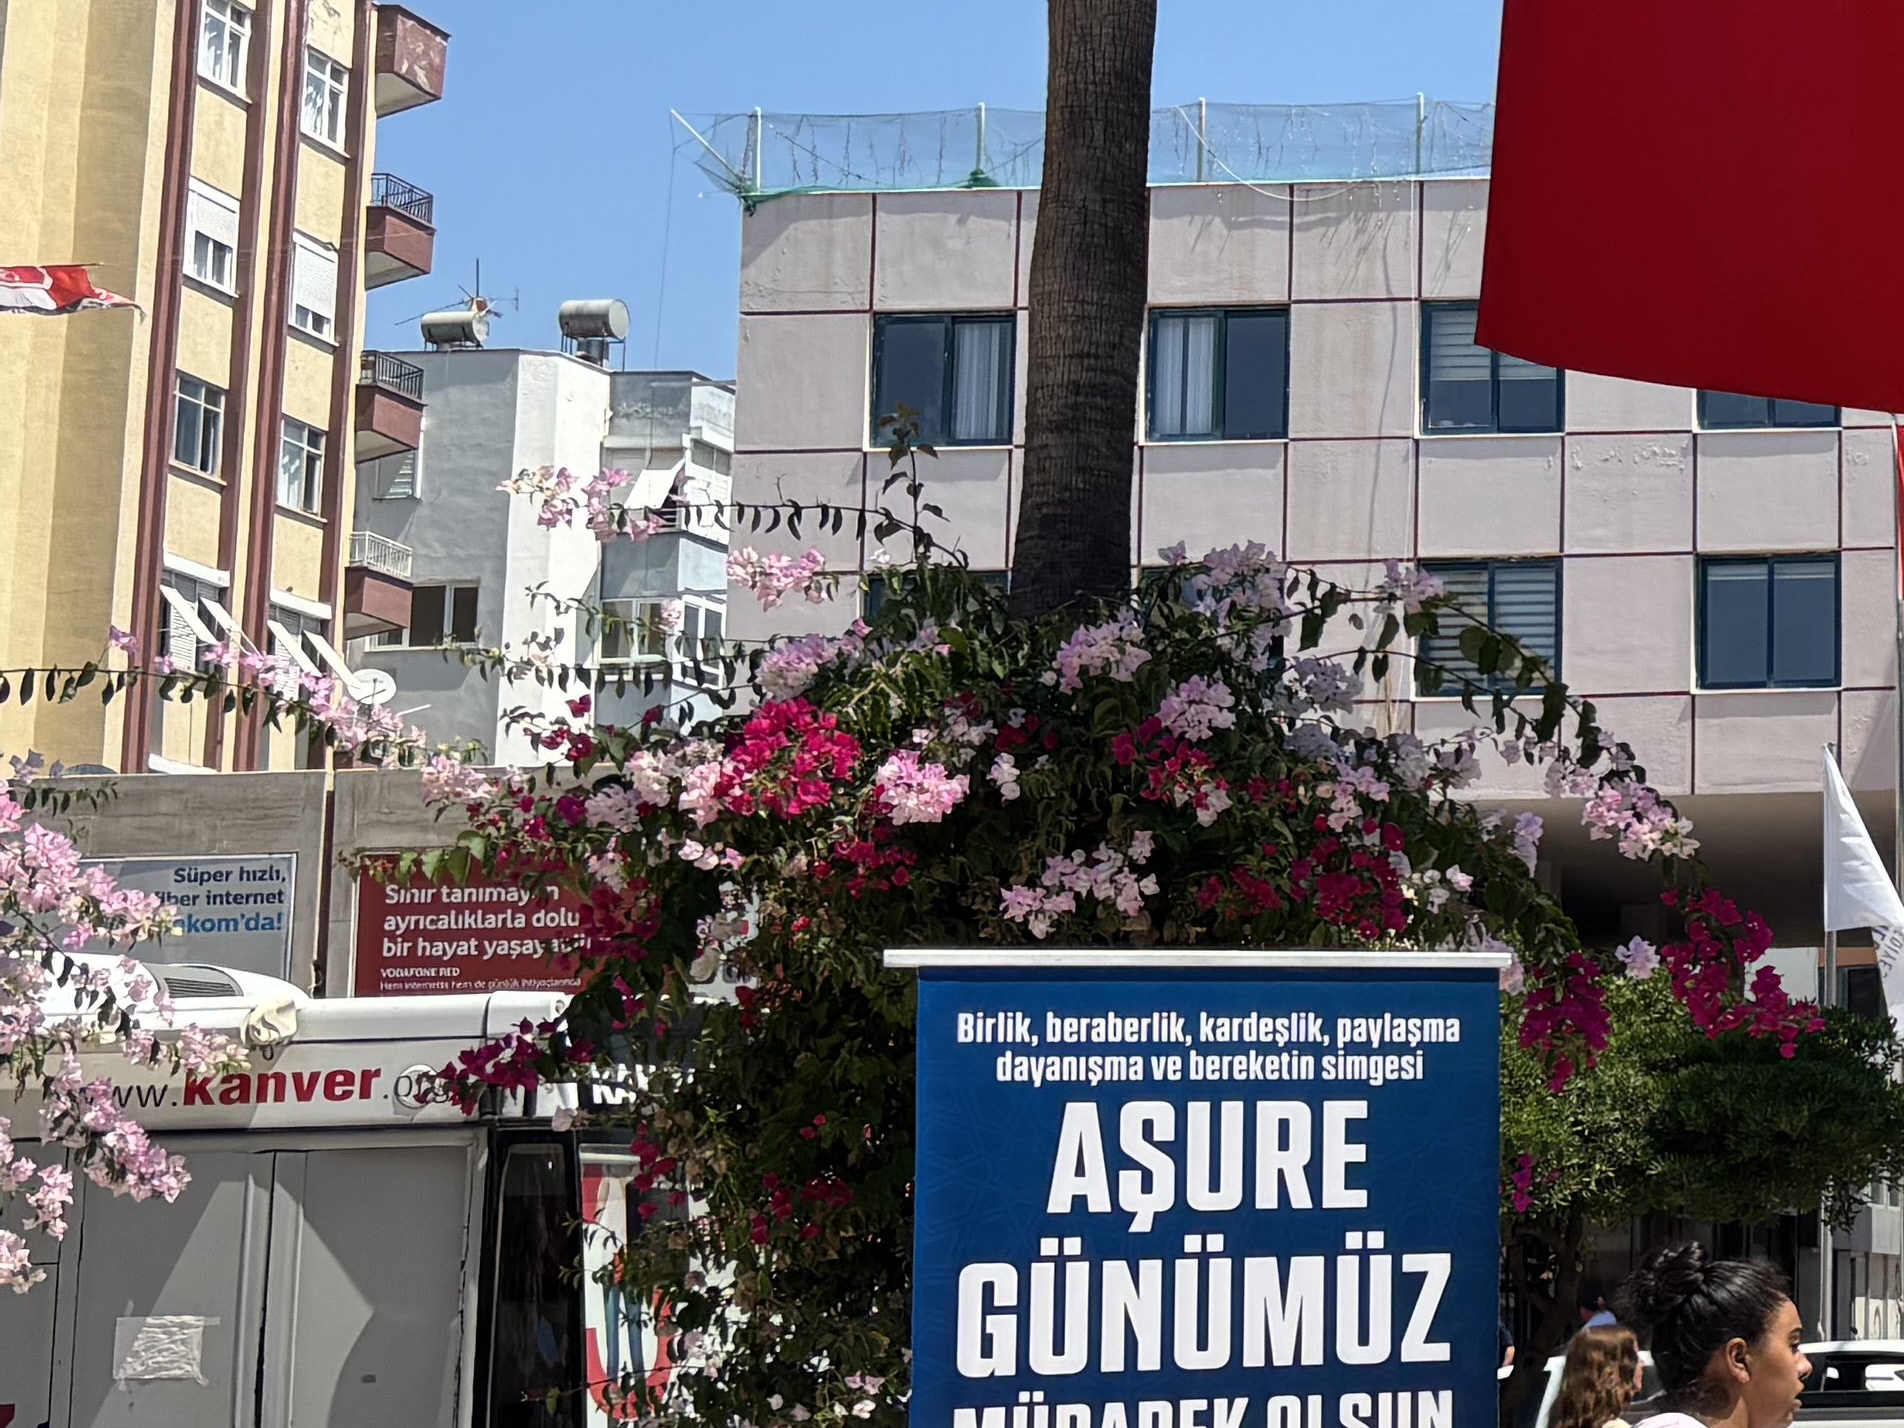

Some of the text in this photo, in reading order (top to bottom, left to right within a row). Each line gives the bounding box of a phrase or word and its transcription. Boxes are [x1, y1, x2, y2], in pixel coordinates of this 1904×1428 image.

[173, 866, 231, 886] Süper
[155, 889, 285, 906] iber internet
[385, 884, 560, 906] Sınır tanımayn
[172, 913, 284, 933] kom'da!
[383, 907, 581, 934] ayrıcalıklarla dolu
[382, 937, 413, 957] bir
[417, 938, 479, 960] hayat
[956, 1011, 1462, 1049] Birlik, beraberlik, kardeşlik, paylaşma
[996, 1049, 1424, 1087] dayanışma ve bereketin simgesi
[1047, 1100, 1370, 1233] AŞURE
[956, 1230, 1452, 1378] GÜNÜMÜZ
